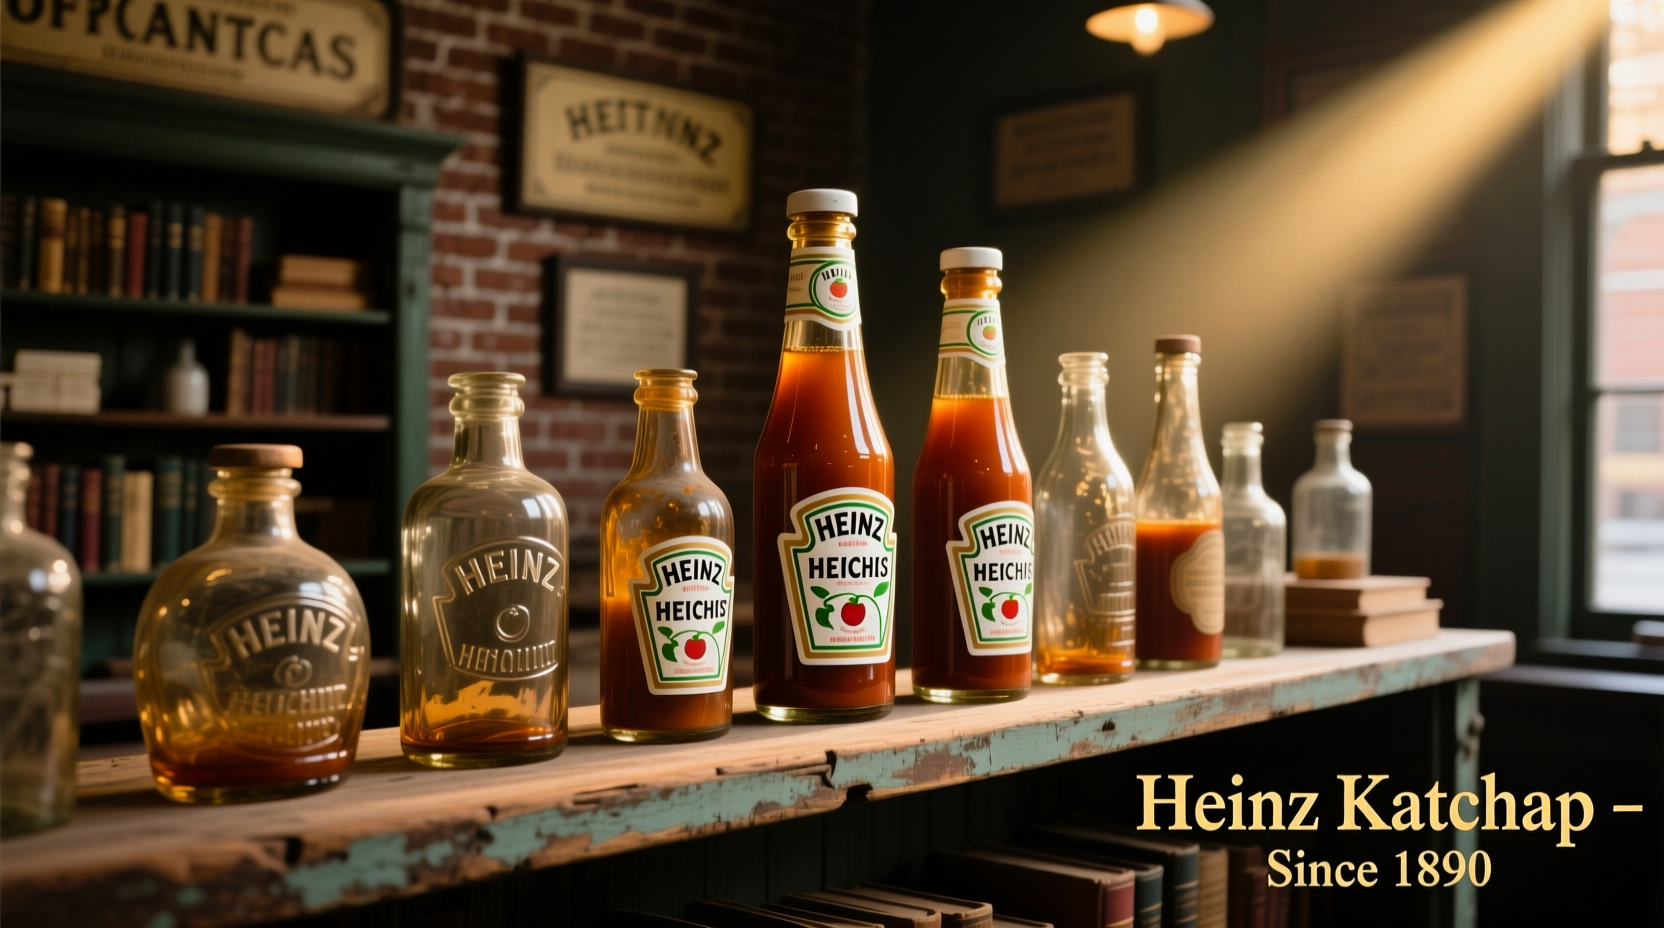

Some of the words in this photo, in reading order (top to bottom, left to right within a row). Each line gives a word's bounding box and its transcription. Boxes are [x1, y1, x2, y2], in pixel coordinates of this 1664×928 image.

[816, 511, 885, 542] HEINZ
[980, 523, 1031, 550] HEINZ
[454, 548, 560, 596] HEINZ
[661, 559, 723, 587] HEINZ
[808, 556, 889, 579] HEICHIS
[656, 600, 727, 622] HEICHIS
[226, 608, 346, 660] HEINZ
